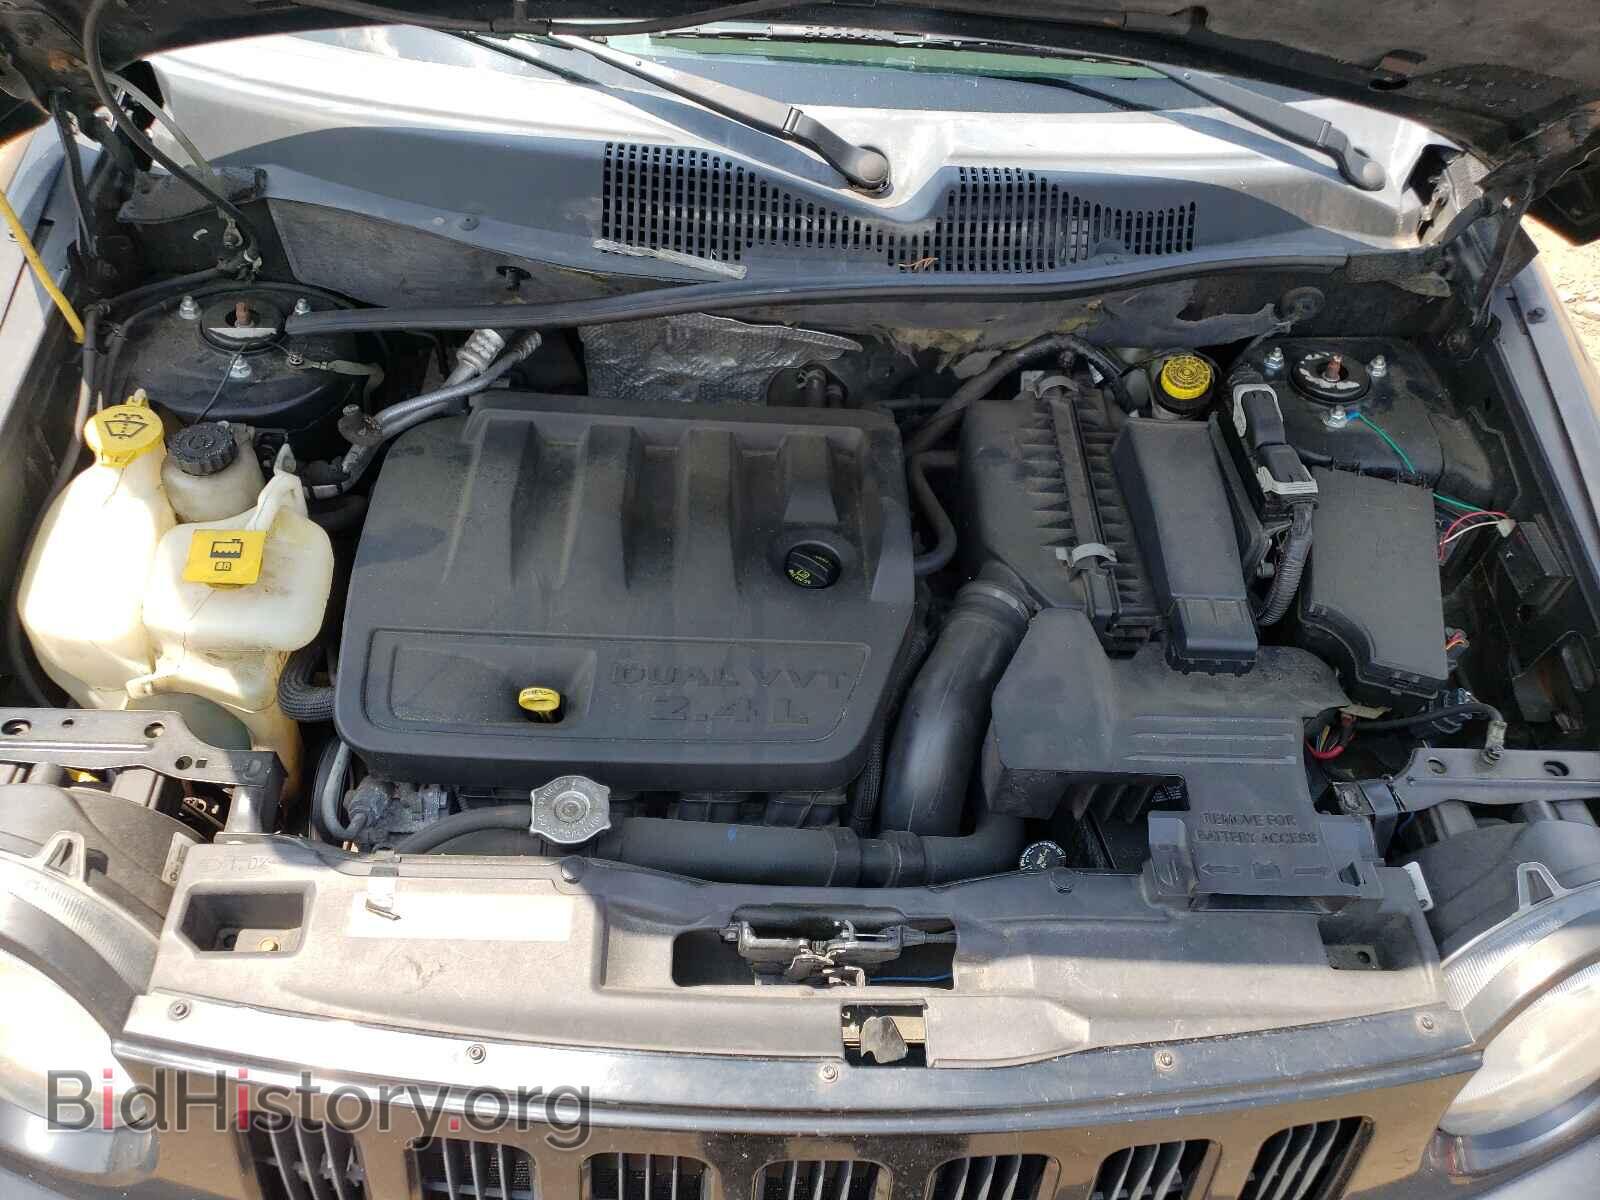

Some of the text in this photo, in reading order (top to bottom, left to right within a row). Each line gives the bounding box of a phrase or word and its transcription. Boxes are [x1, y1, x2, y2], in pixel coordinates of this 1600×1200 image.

[610, 661, 851, 689] DUAL VVT
[649, 696, 810, 726] 2.4L
[1201, 813, 1297, 826] REMOVE FOR
[1196, 830, 1320, 844] BATTERY ACCESS
